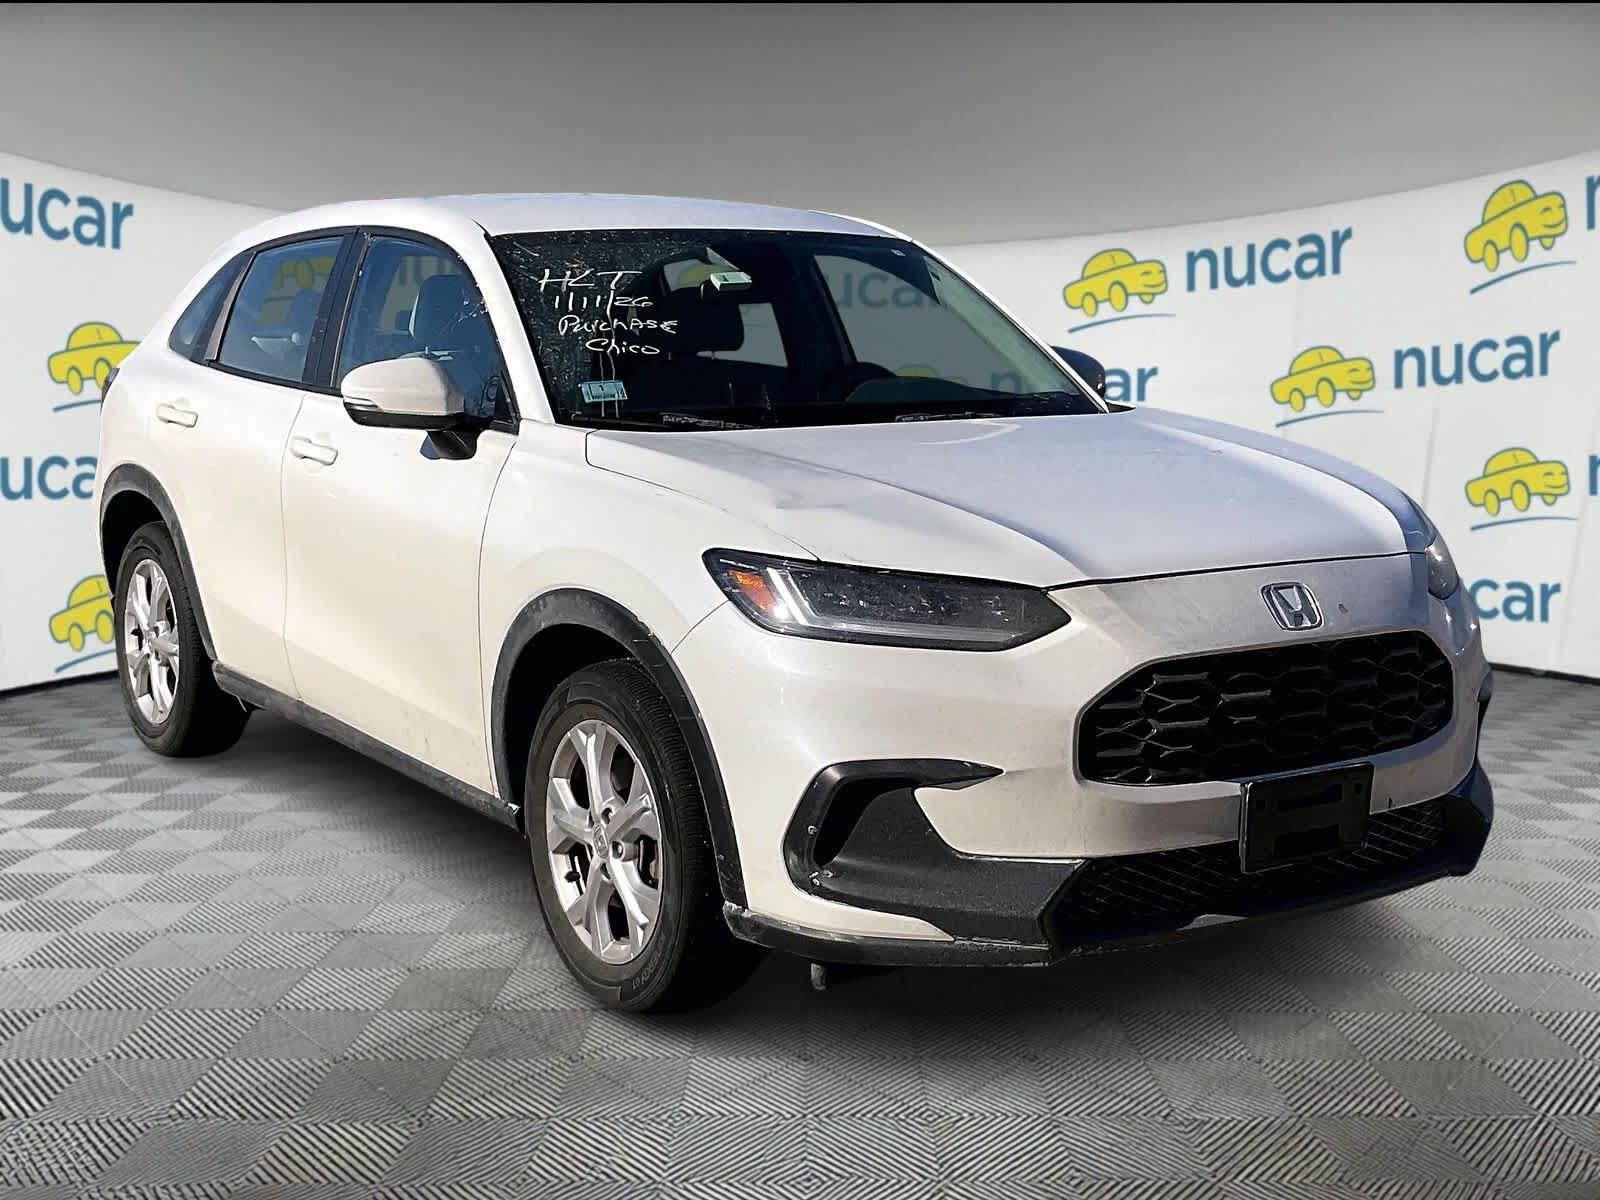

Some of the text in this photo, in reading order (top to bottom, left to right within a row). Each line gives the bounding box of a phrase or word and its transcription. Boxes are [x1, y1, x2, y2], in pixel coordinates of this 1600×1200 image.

[0, 177, 134, 250] ucar
[1186, 226, 1352, 292] nucar
[1393, 329, 1560, 390] nucar
[0, 455, 98, 500] uca
[1468, 578, 1561, 623] car
